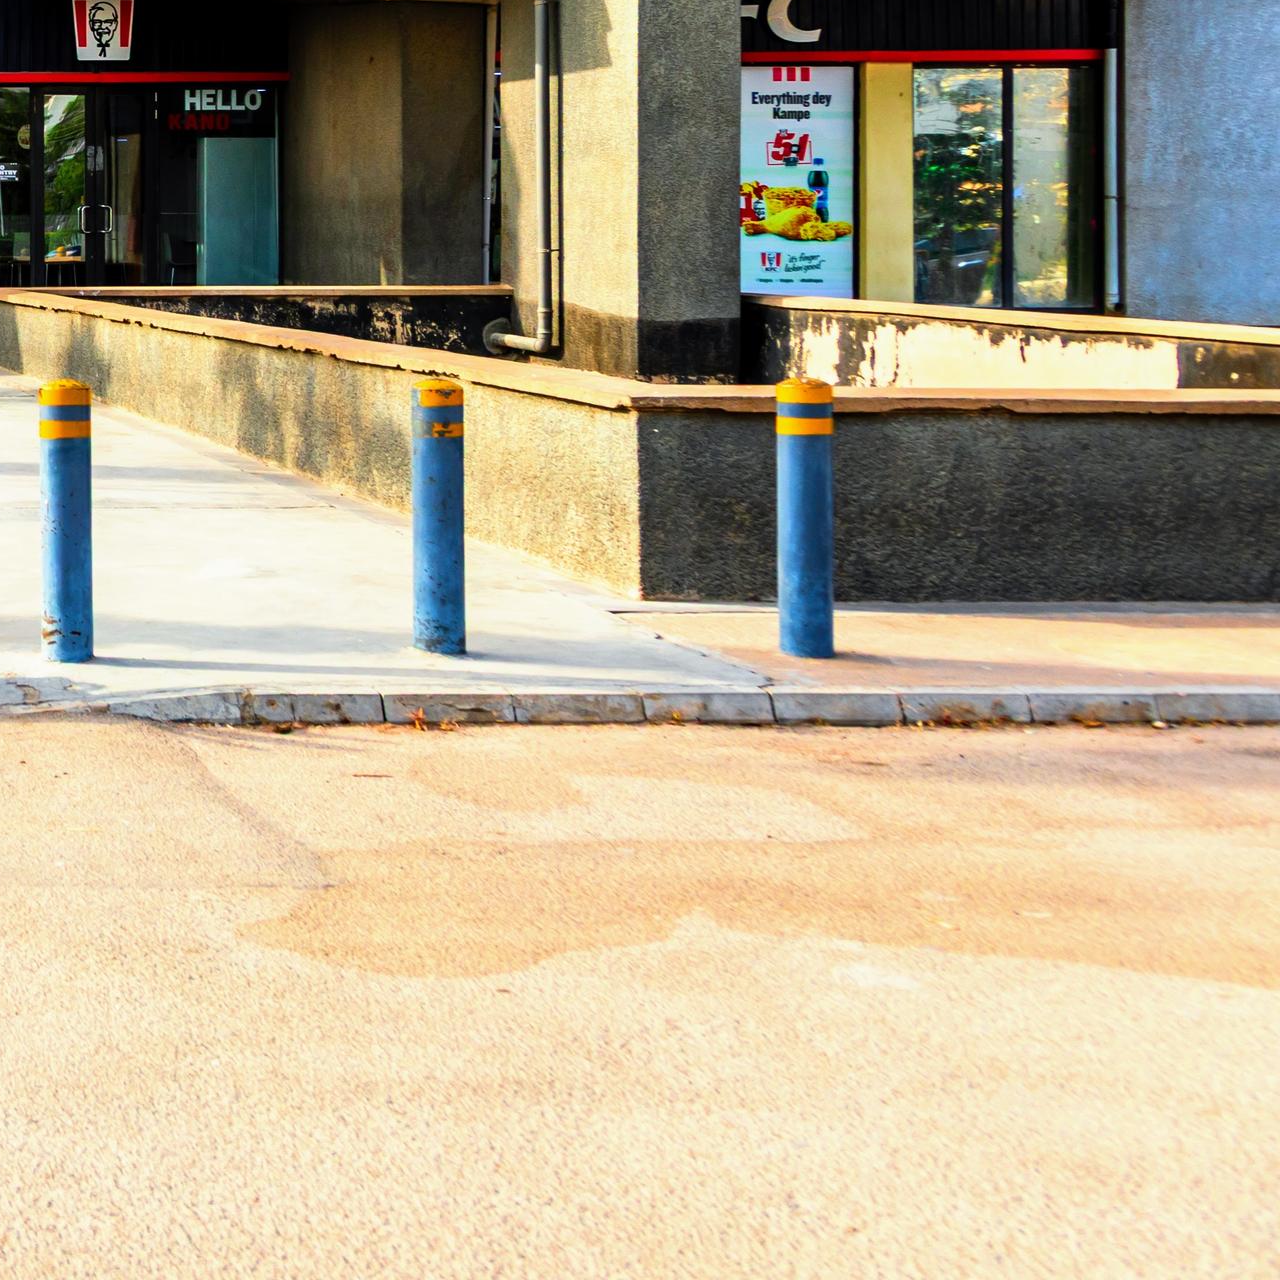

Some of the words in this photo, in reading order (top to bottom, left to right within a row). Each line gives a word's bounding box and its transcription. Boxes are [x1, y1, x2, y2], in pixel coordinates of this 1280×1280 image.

[184, 89, 262, 111] HELLO
[751, 91, 811, 107] Everything
[812, 91, 832, 107] dey
[772, 107, 811, 122] Kampe
